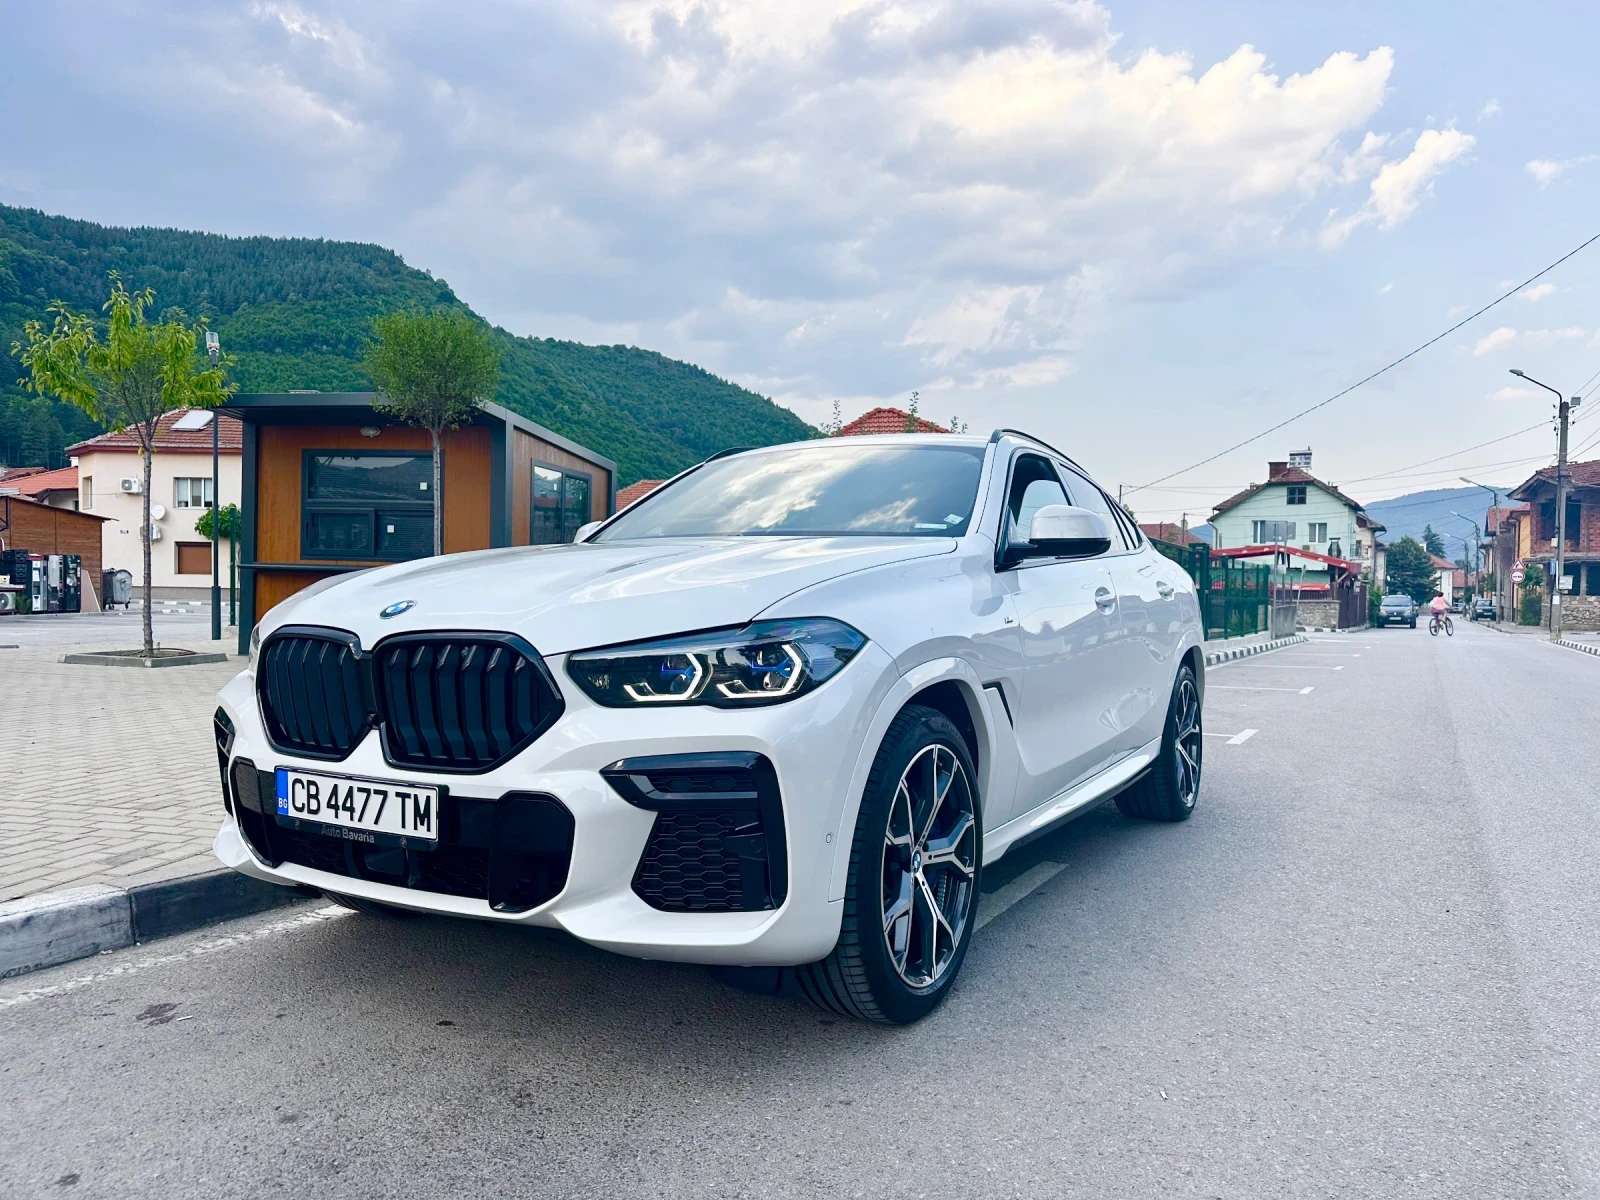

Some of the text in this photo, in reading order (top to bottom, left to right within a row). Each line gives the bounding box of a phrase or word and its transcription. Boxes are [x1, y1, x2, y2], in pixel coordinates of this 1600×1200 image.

[278, 797, 288, 809] BG
[291, 778, 431, 832] CB 4477 TM
[321, 825, 375, 843] Auto Bavaria
